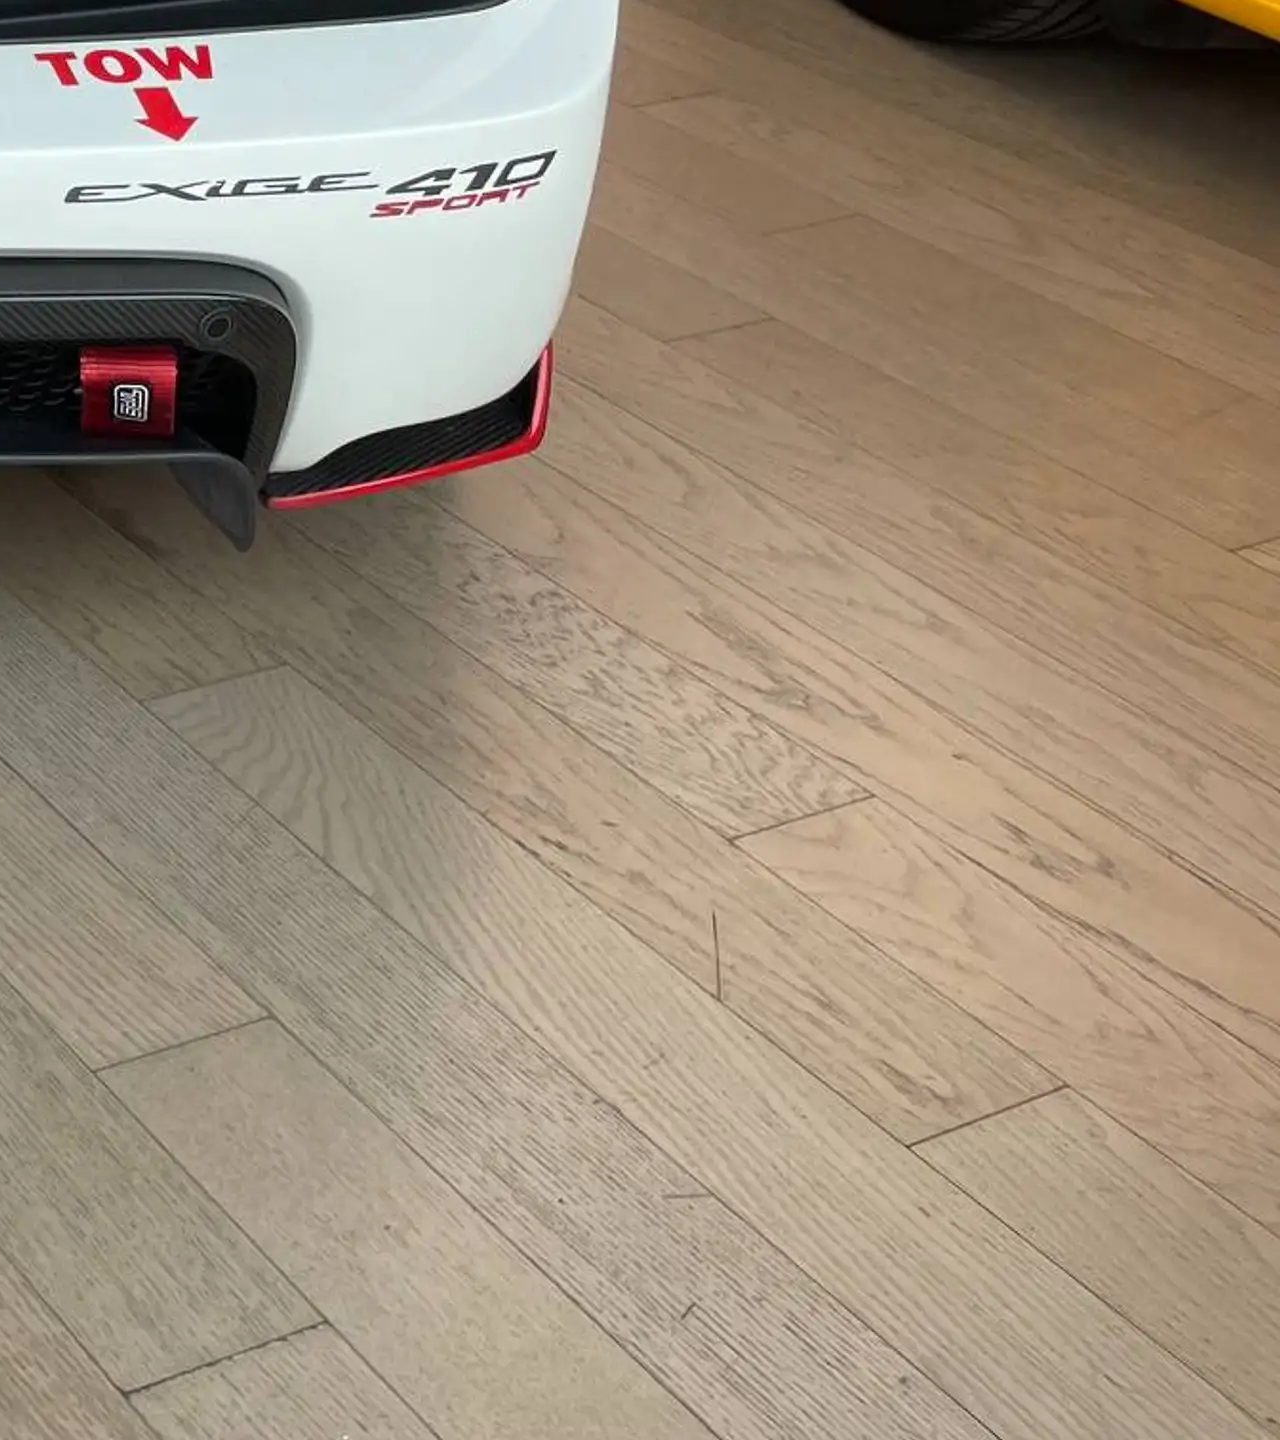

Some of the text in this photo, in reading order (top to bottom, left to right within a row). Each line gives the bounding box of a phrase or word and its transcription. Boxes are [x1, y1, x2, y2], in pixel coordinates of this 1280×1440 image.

[34, 44, 214, 87] TOW
[385, 149, 558, 198] 410
[369, 180, 541, 218] SPORT
